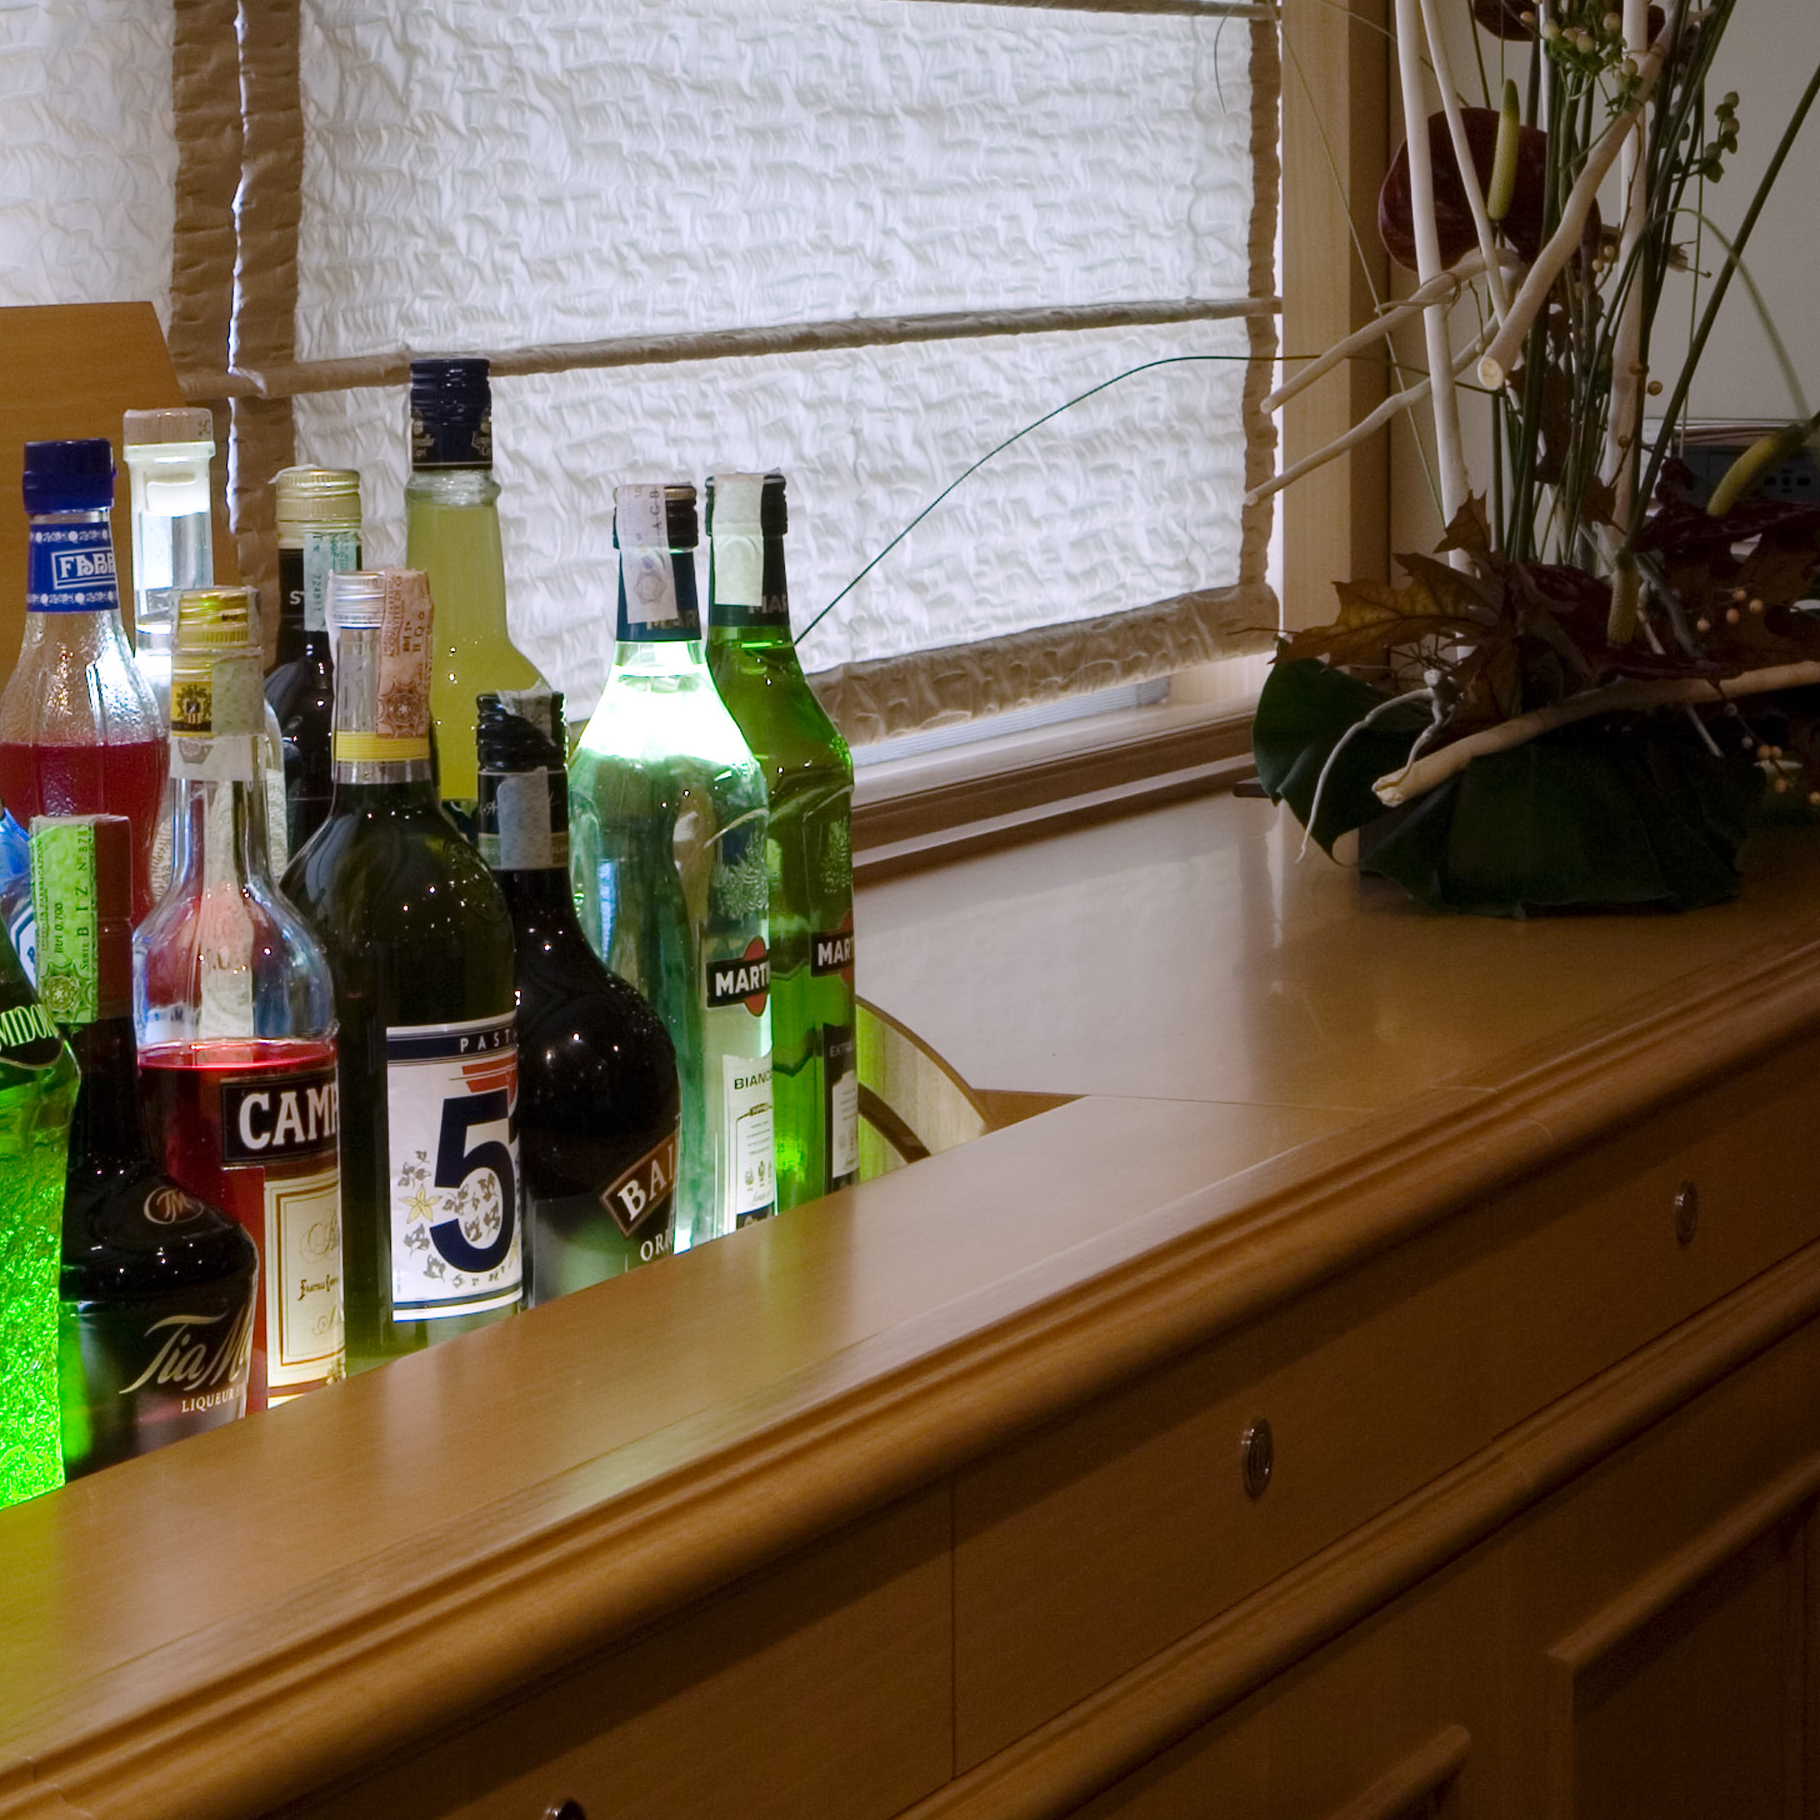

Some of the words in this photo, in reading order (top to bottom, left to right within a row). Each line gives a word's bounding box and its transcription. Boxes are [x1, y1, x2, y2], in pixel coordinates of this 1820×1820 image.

[818, 937, 854, 967] MAR
[119, 1310, 230, 1396] Tia
[180, 1386, 235, 1415] LIQUEUR
